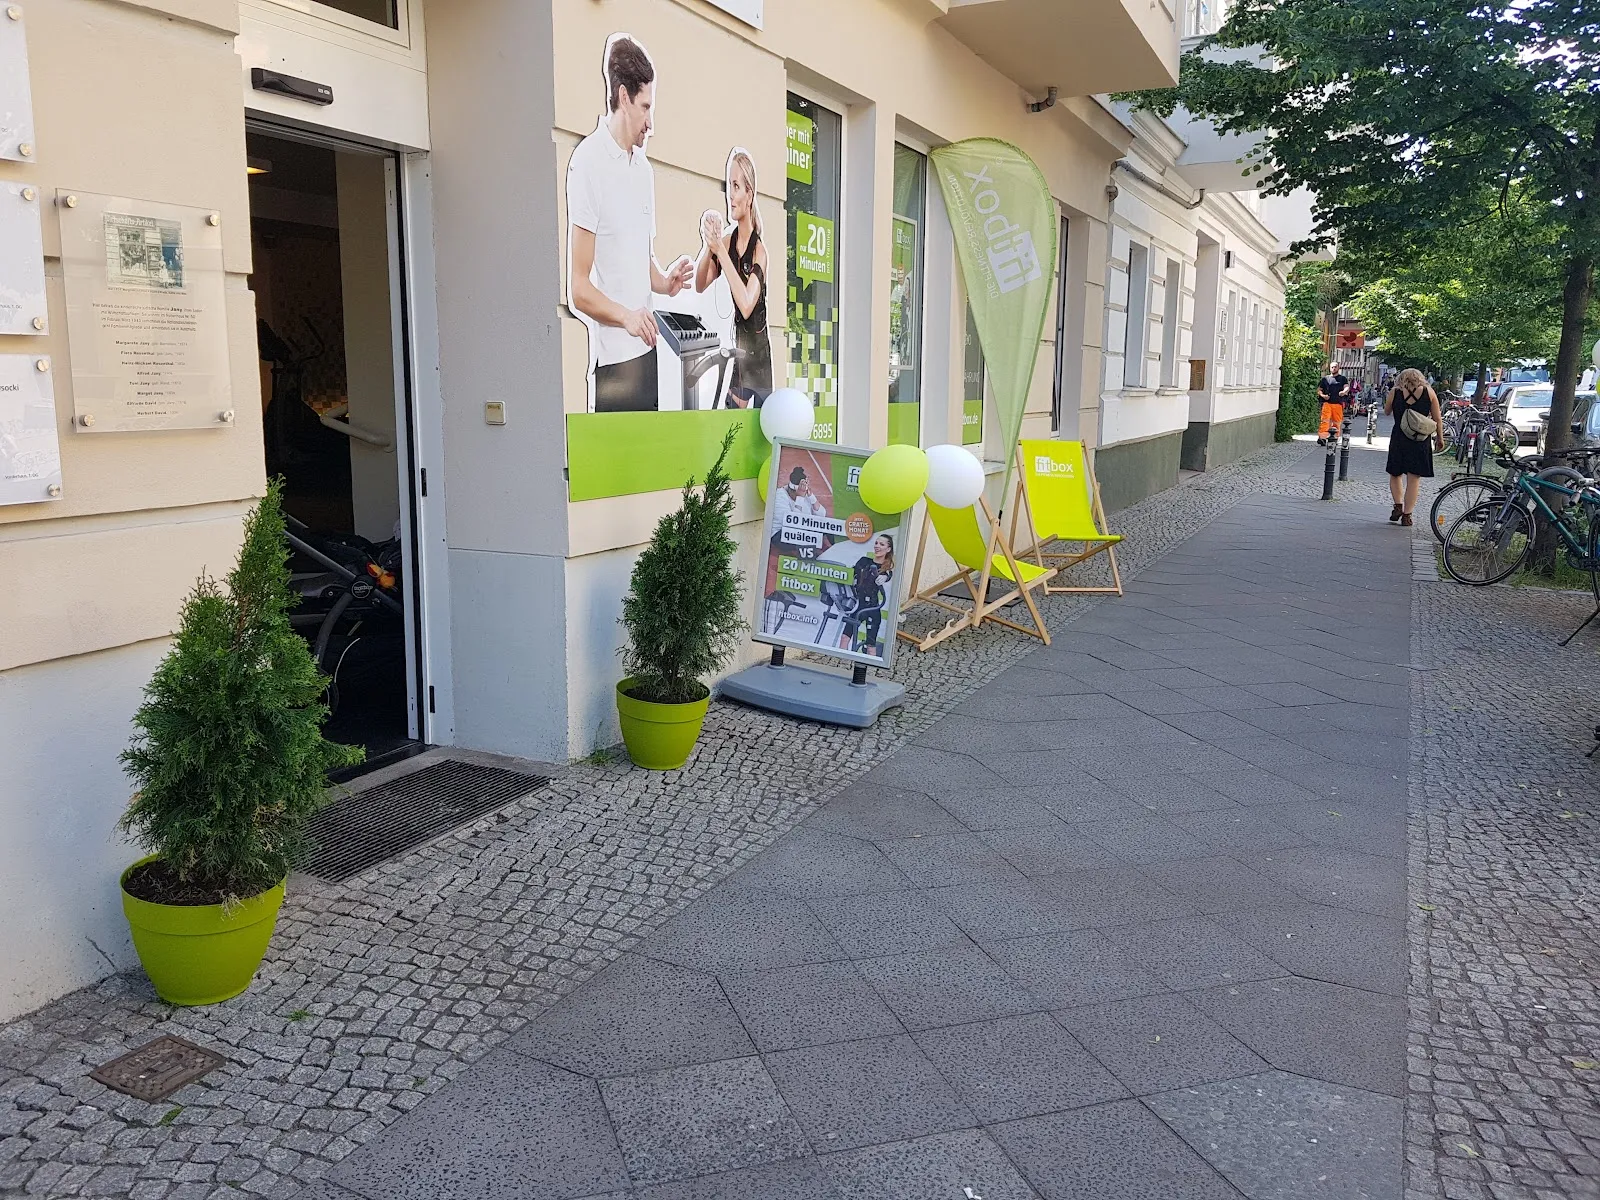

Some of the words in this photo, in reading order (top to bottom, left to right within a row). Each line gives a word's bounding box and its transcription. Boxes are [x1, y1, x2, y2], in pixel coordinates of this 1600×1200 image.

[798, 130, 810, 146] mit
[808, 223, 826, 256] 20
[800, 255, 826, 273] Minuten
[813, 423, 832, 439] 6895
[1035, 456, 1073, 473] fitbox
[786, 515, 799, 525] 60
[801, 517, 842, 532] Minuten
[784, 531, 817, 544] quälen
[783, 559, 798, 570] 20
[800, 562, 847, 580] Minuten
[781, 576, 815, 592] fitbox
[778, 610, 818, 624] fitbox.info
